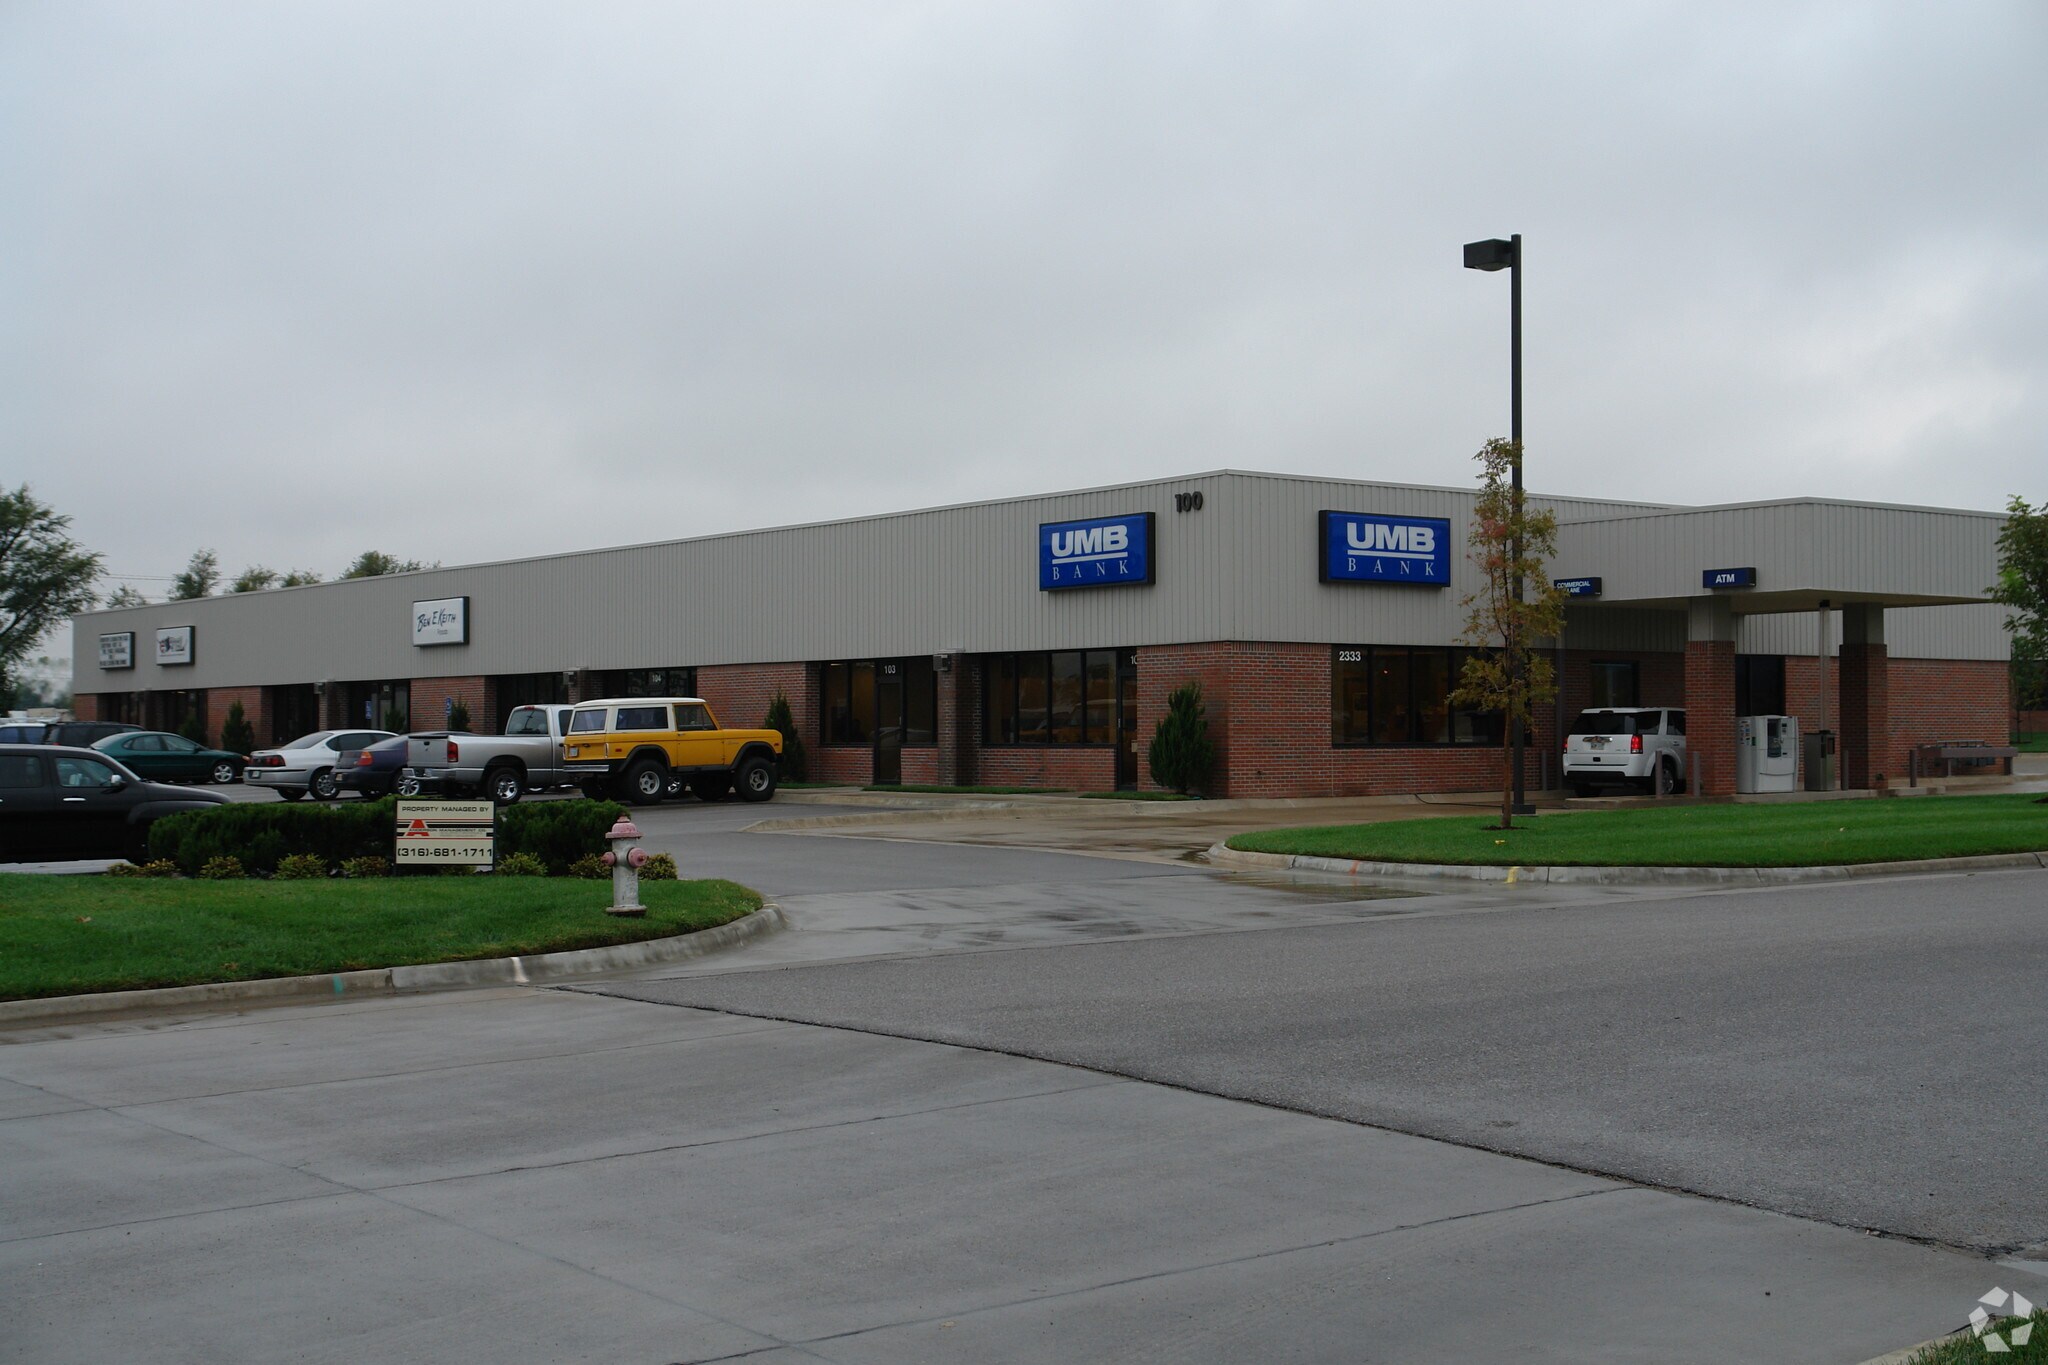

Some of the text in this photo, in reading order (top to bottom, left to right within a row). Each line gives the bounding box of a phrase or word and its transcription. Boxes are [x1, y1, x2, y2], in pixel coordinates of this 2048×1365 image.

[1175, 491, 1203, 513] 100
[1052, 525, 1128, 557] UMB
[1347, 522, 1435, 552] UMB
[1053, 560, 1128, 580] BANK
[1348, 558, 1434, 576] BANK
[1557, 581, 1590, 589] COMMERCIAL
[1715, 574, 1735, 583] ATM
[1339, 651, 1361, 661] 2333
[884, 665, 896, 674] 103
[397, 848, 492, 857] (316)-681-1711
